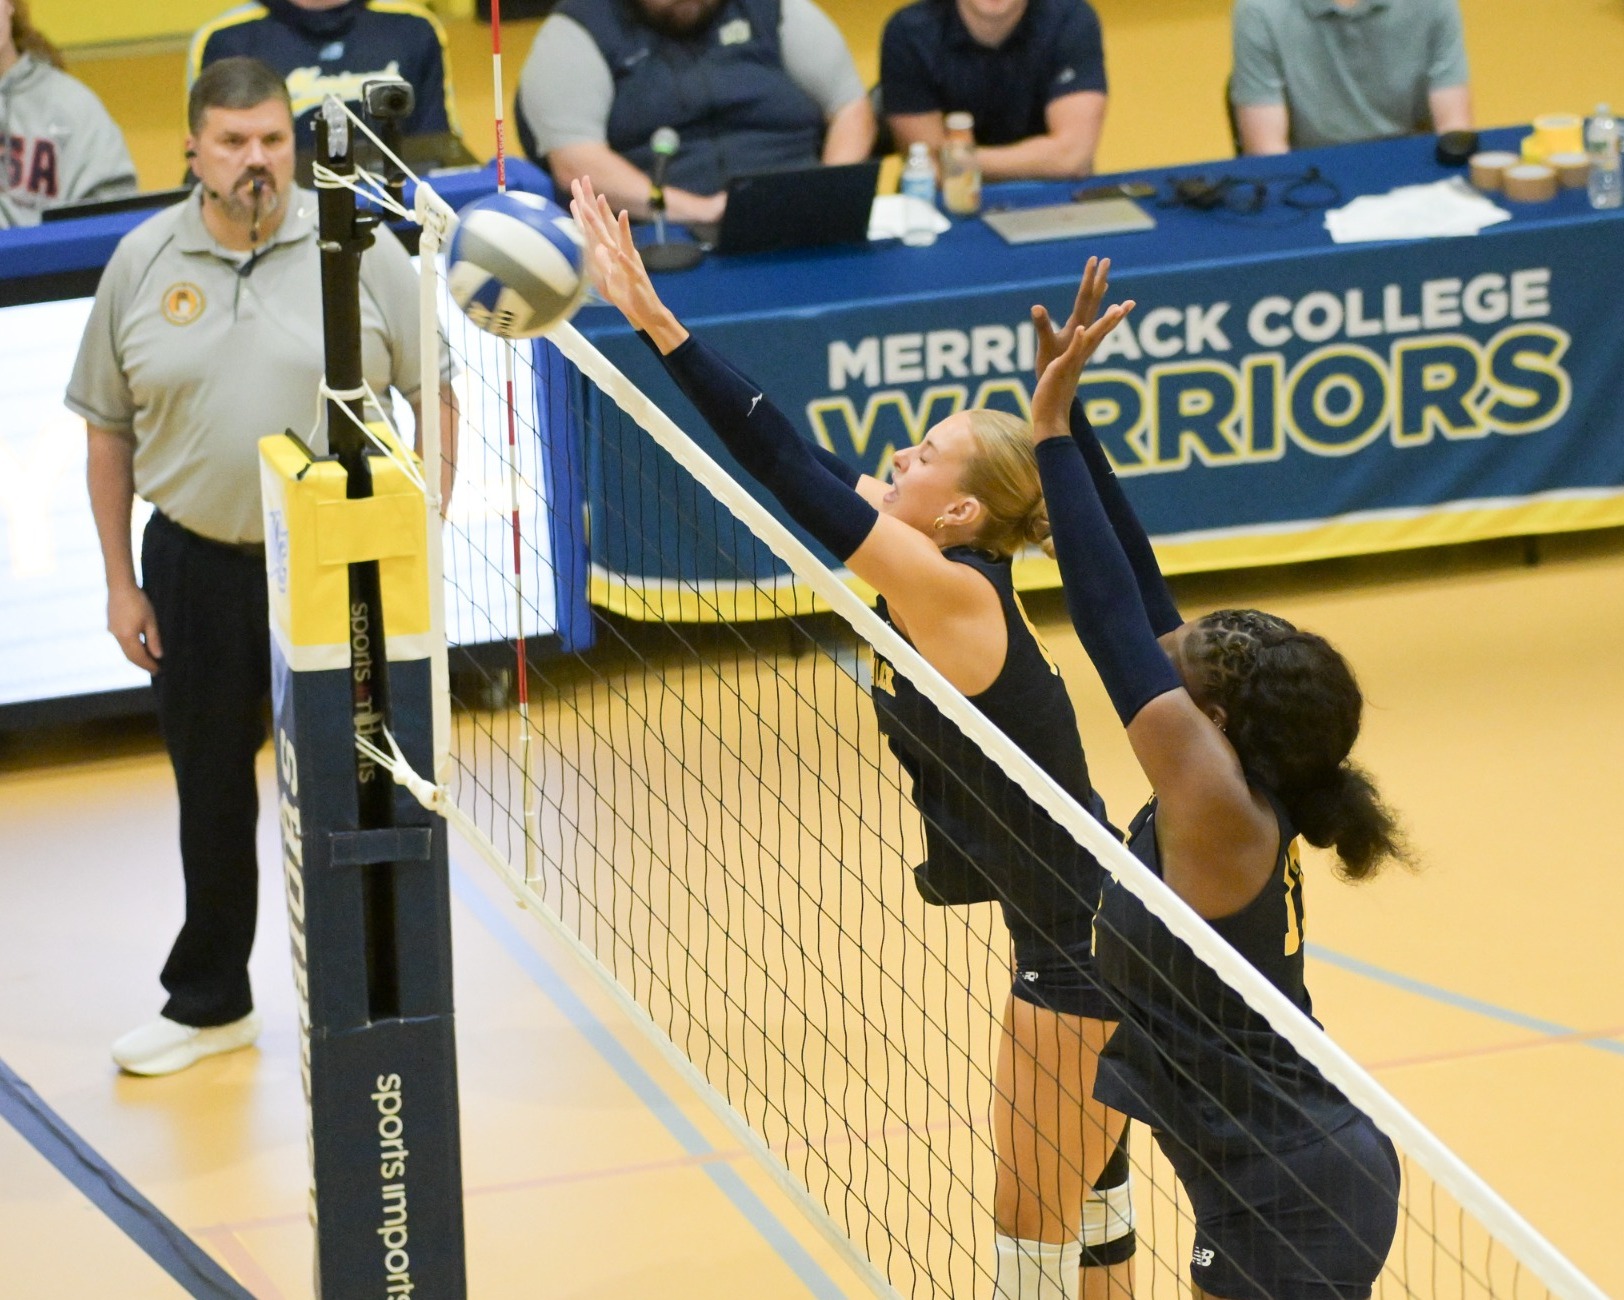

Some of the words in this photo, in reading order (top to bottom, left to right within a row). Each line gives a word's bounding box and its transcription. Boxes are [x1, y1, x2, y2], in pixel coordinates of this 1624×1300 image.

[828, 302, 1232, 390] MERRIACK
[1248, 267, 1551, 347] COLLEGE
[351, 602, 373, 682] sports
[370, 1073, 410, 1179] sports
